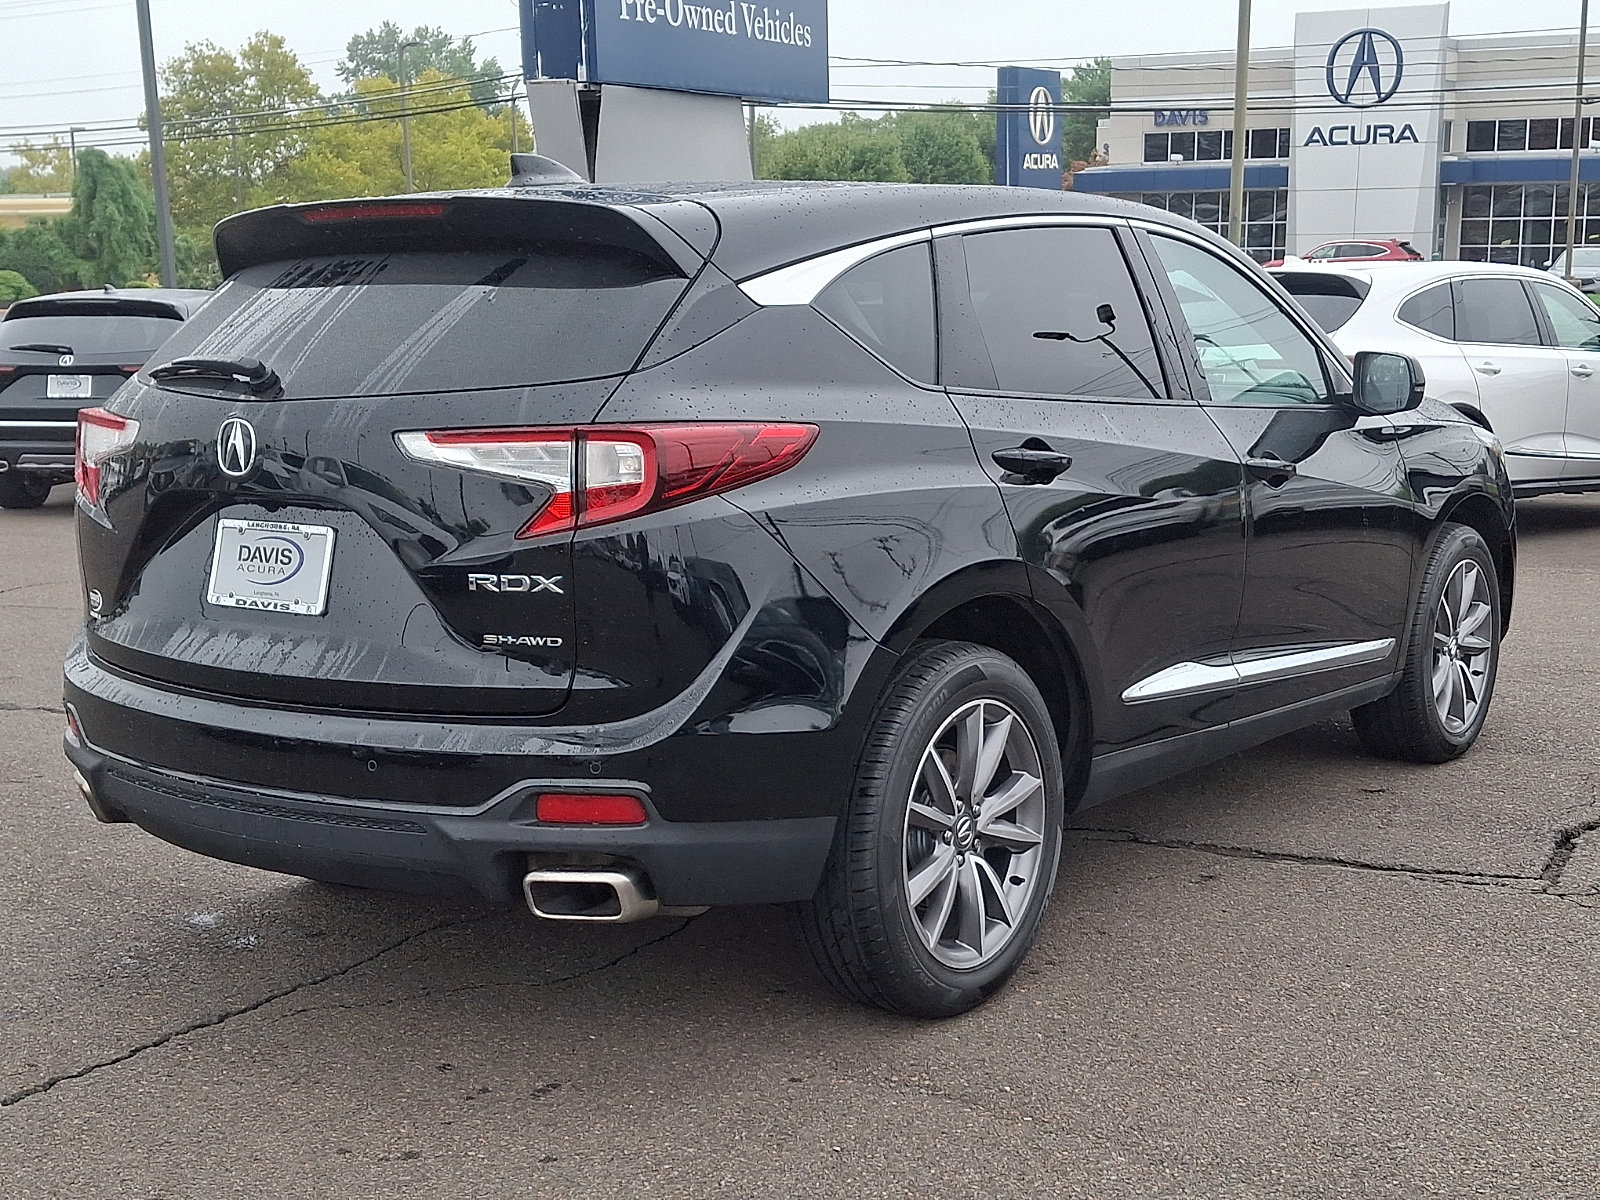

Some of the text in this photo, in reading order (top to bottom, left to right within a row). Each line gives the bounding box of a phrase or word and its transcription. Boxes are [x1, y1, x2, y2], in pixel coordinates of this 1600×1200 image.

[740, 2, 812, 47] Vehicles
[1153, 109, 1209, 127] DAVIS
[1303, 123, 1419, 146] ACURA
[1023, 153, 1059, 169] ACURA
[238, 544, 293, 566] DAVIS
[236, 563, 286, 576] ACURA
[467, 573, 564, 594] RDX
[235, 598, 291, 611] DAVIS
[482, 634, 563, 647] SH-AWD
